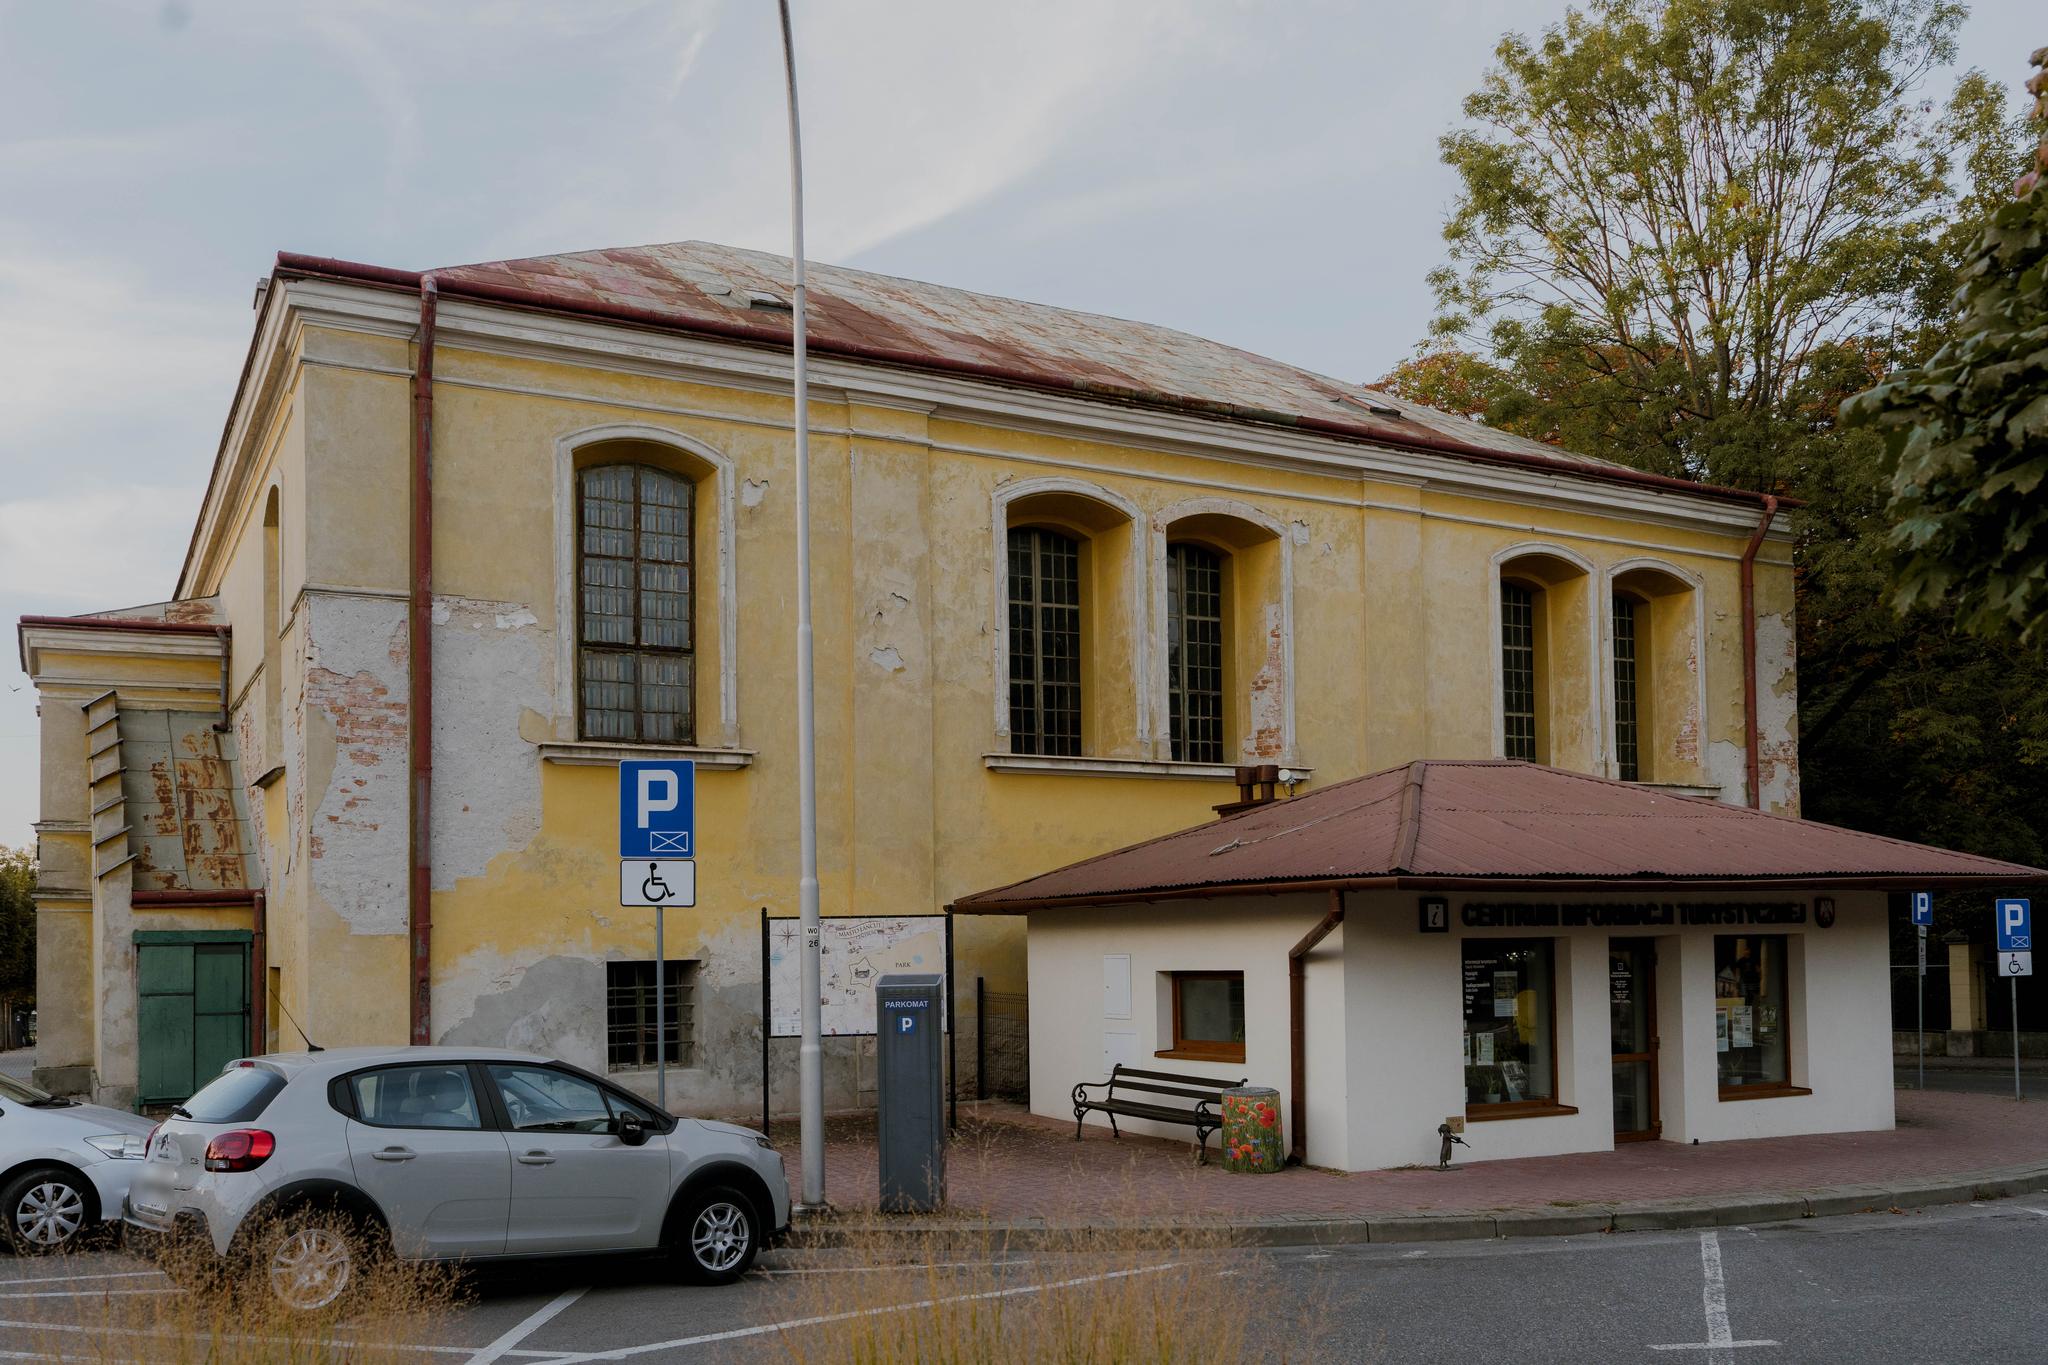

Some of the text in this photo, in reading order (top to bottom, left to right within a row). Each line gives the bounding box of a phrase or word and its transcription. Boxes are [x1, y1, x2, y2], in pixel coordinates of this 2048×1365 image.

[637, 769, 679, 829] P
[1461, 902, 1807, 926] CENTRUM INFORMACJI TURYSTYCZNEJ
[1917, 893, 1928, 920] P
[2005, 904, 2023, 935] P
[808, 939, 819, 948] 26
[885, 1000, 929, 1008] PARKOMAT
[902, 1017, 913, 1032] P
